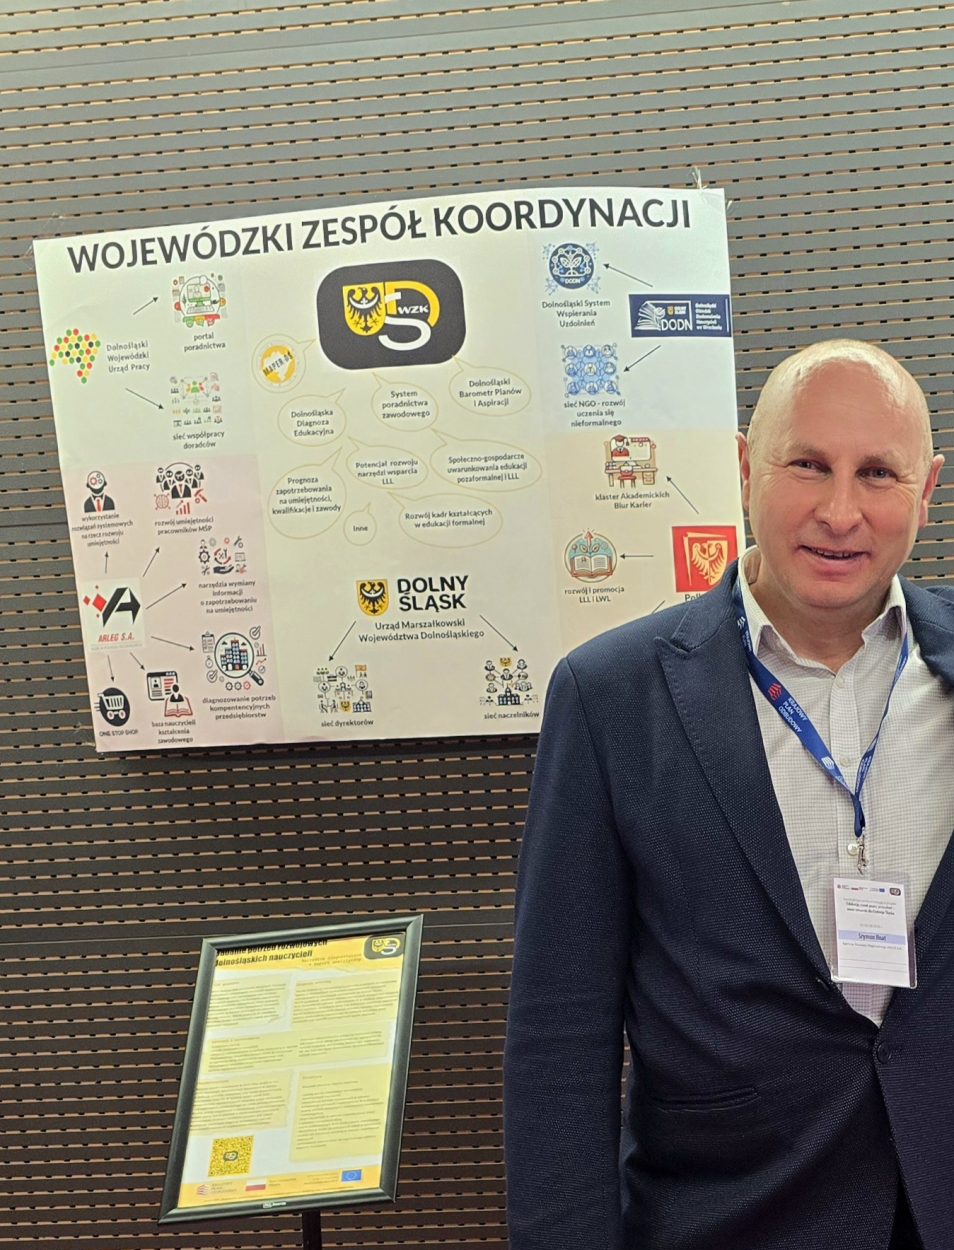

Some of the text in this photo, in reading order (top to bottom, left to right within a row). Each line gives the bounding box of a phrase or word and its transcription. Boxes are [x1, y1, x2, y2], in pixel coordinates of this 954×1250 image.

[67, 198, 691, 274] WOJEWÓDZKI ZESPÓŁ KOORDYNACJI
[398, 304, 429, 314] WZK
[542, 300, 611, 309] Dolnośląski System
[556, 310, 597, 319] Wspierania
[559, 320, 596, 328] Uzdolnień
[661, 319, 693, 331] DODN
[193, 332, 215, 344] portal
[106, 341, 149, 352] Dolnośląski
[183, 341, 226, 353] poradnictwa
[107, 351, 150, 364] Wojewódzki
[108, 362, 151, 374] Urząd Pracy
[469, 378, 511, 388] Dolnośląski
[390, 390, 418, 399] System
[459, 386, 523, 399] Barometr Planów
[382, 398, 429, 410] poradnictwa
[477, 398, 509, 409] Aspiracji
[602, 400, 626, 409] rozwój
[290, 410, 334, 419] Dolnośląska
[382, 409, 431, 420] zawodowego
[604, 409, 615, 418] się
[296, 419, 330, 428] Diagnoza
[570, 419, 622, 428] nieformalnego
[172, 430, 225, 443] sieć współpracy
[294, 428, 334, 438] Edukacyjna
[183, 440, 217, 450] doradców
[355, 459, 419, 470] Potencjał rozwoju
[448, 454, 525, 464] Społeczno-gospodarcze
[357, 468, 418, 479] narzędzi wsparcia
[447, 462, 528, 474] uwarunkowania edukacji
[287, 477, 319, 487] Prognoza
[382, 478, 394, 486] LLL
[457, 473, 520, 484] pozaformalnej LLL
[275, 486, 332, 496] zapotrzebowania
[595, 492, 670, 501] klaster Akademickich
[272, 504, 342, 516] kwalifikacje zawody
[614, 501, 652, 510] Biur Karier
[405, 509, 493, 521] Rozwój kadr kształcących
[154, 520, 175, 528] rozwój
[422, 520, 451, 529] edukacji
[452, 519, 485, 529] formalnej
[157, 526, 198, 536] pracowników
[397, 575, 469, 594] DOLNY
[564, 586, 625, 596] rozwój promocja
[399, 592, 468, 613] ŚLĄSK
[579, 596, 591, 604] LLL
[375, 618, 466, 632] Urząd Marszałkowski
[358, 629, 485, 644] Województwa Dolnośląskiego
[251, 694, 277, 702] potrzeb
[783, 701, 795, 715] PLAN
[787, 697, 808, 722] KRAJOWY
[778, 706, 802, 733] ODBUDOWY
[269, 951, 313, 962] nauczycieli
